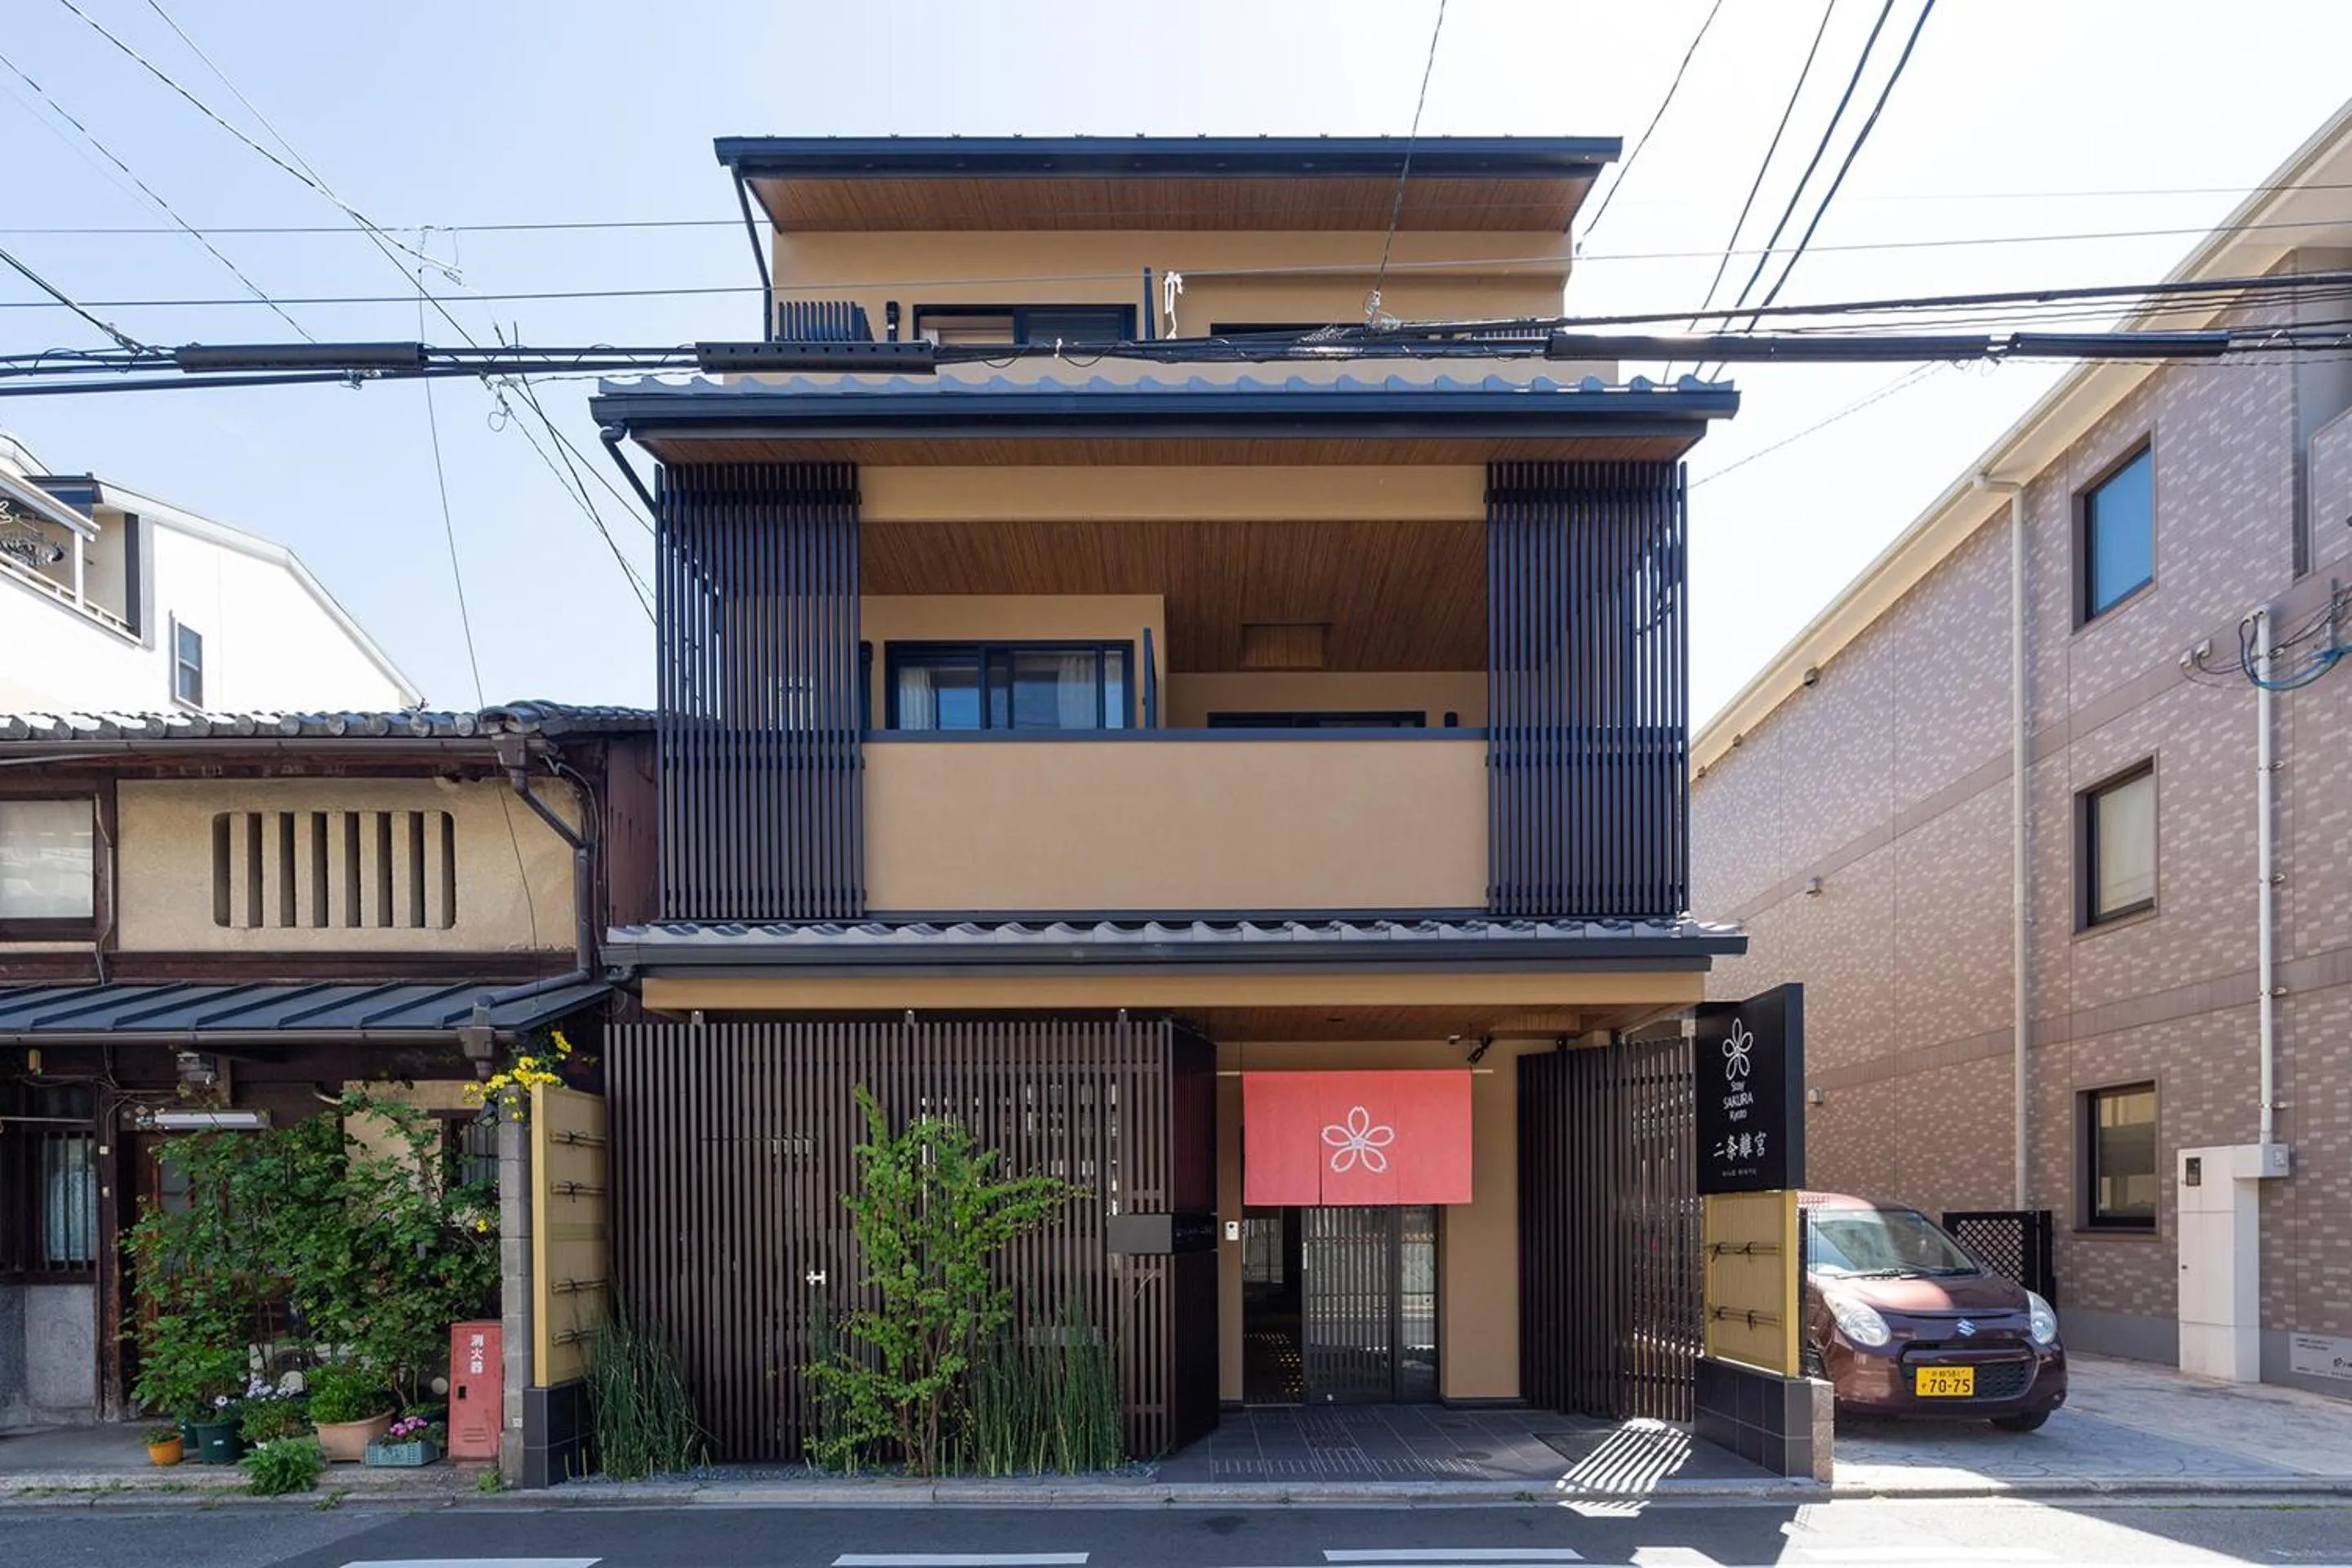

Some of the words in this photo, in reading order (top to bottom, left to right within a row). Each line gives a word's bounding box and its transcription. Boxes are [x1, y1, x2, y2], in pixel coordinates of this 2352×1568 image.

[1723, 1092, 1754, 1110] SAKURA
[1713, 1130, 1766, 1160] 二条離宮
[470, 1334, 484, 1374] 消火器
[1930, 1379, 1971, 1393] 70-75
